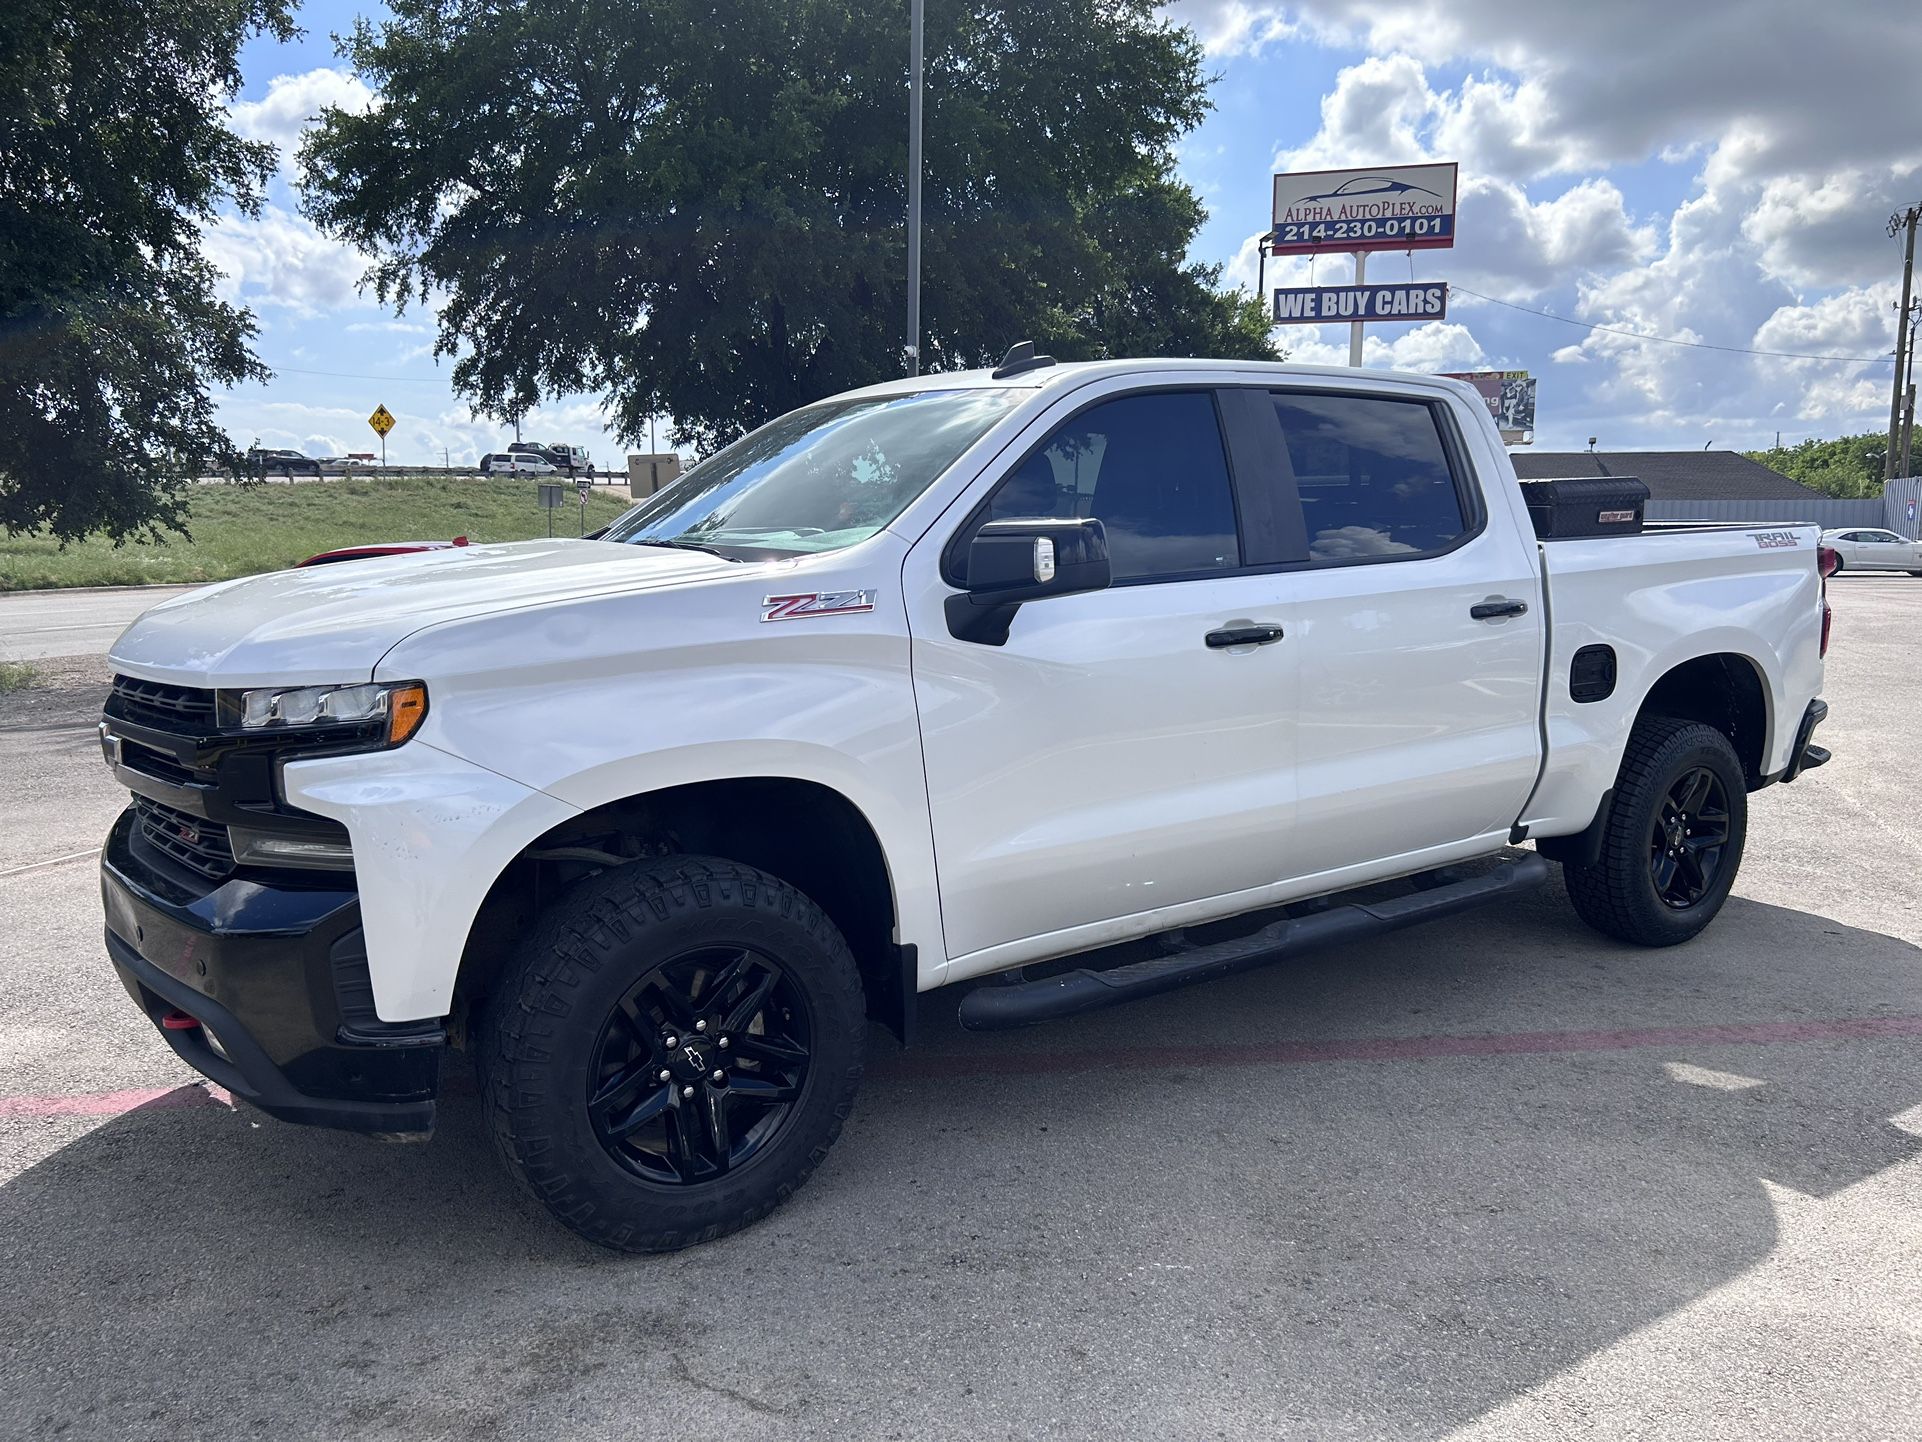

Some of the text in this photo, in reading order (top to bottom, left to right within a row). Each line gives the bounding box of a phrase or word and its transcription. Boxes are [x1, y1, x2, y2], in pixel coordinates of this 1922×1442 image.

[1284, 206, 1333, 222] ALPHA
[1284, 217, 1441, 240] 214-230-0101
[1278, 288, 1442, 318] WE BUY CARS
[1506, 370, 1525, 379] EXIT
[1746, 531, 1801, 541] TRAIL
[1757, 540, 1797, 549] BOSS
[760, 588, 877, 622] Z71
